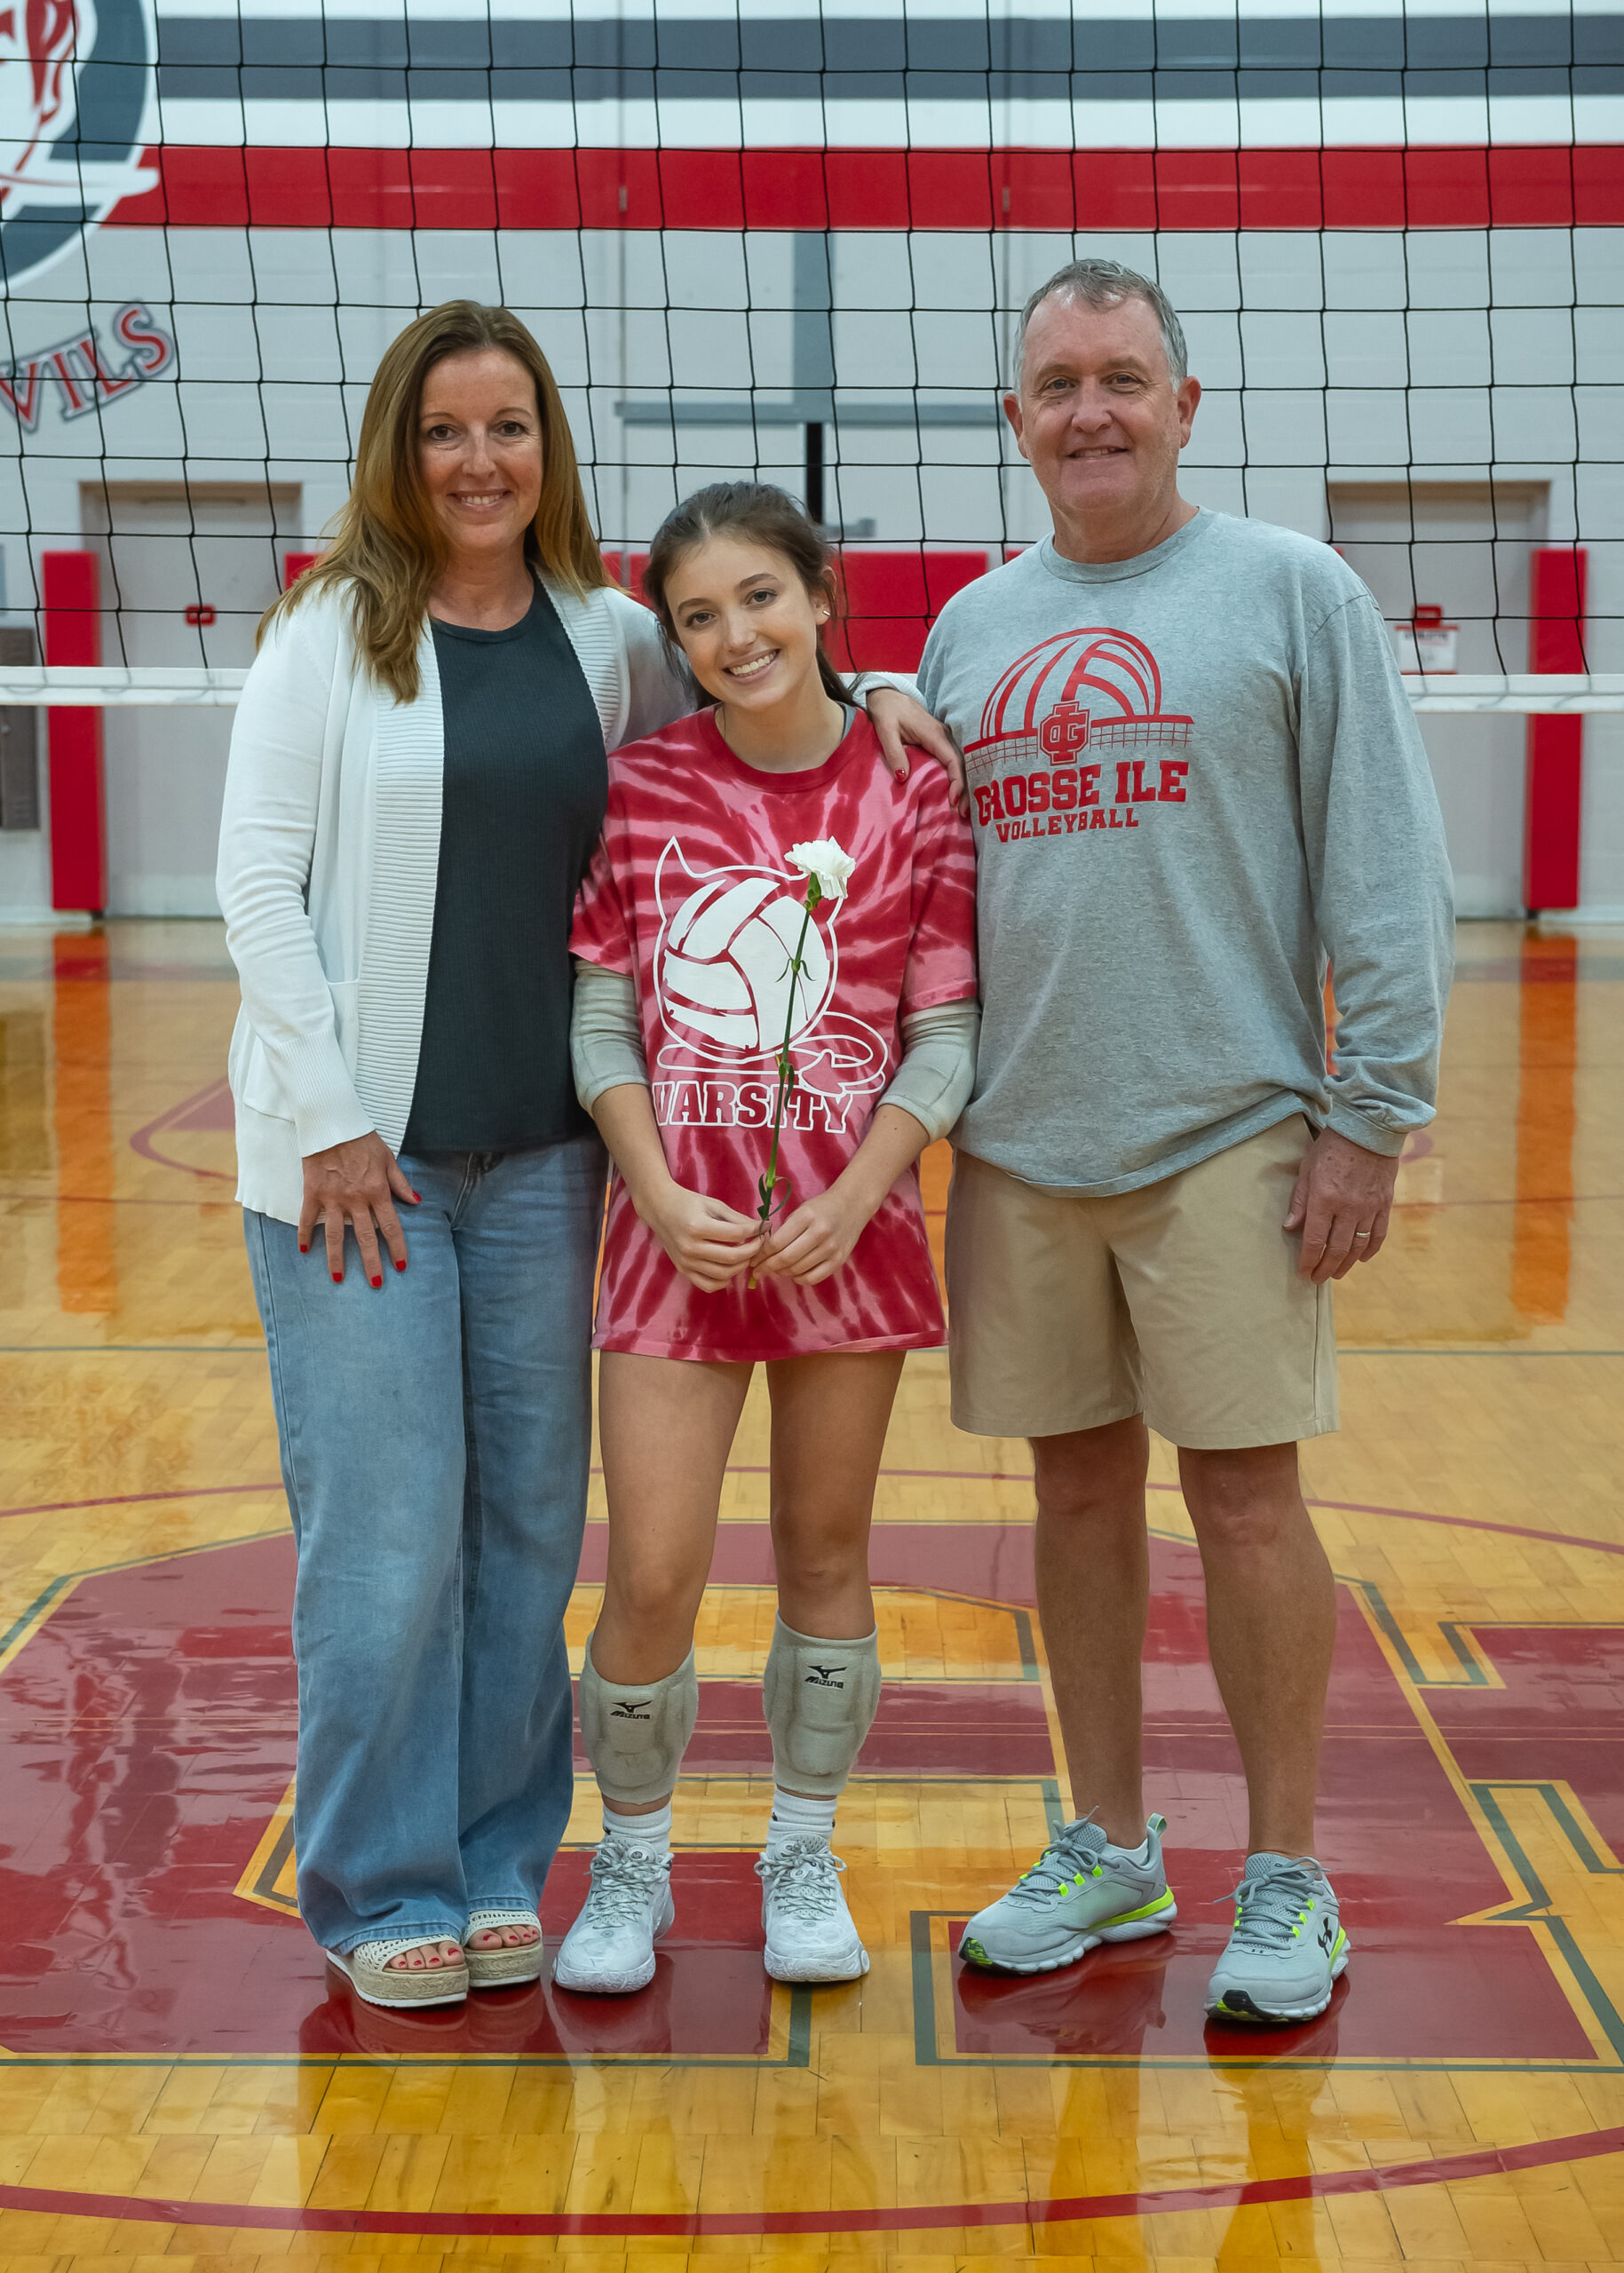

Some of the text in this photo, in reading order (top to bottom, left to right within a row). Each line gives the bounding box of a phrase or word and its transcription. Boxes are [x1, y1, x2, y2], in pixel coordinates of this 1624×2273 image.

[1114, 760, 1190, 804] ILE
[995, 808, 1139, 843] VOLLEYBALL
[652, 1080, 853, 1134] VARSITY
